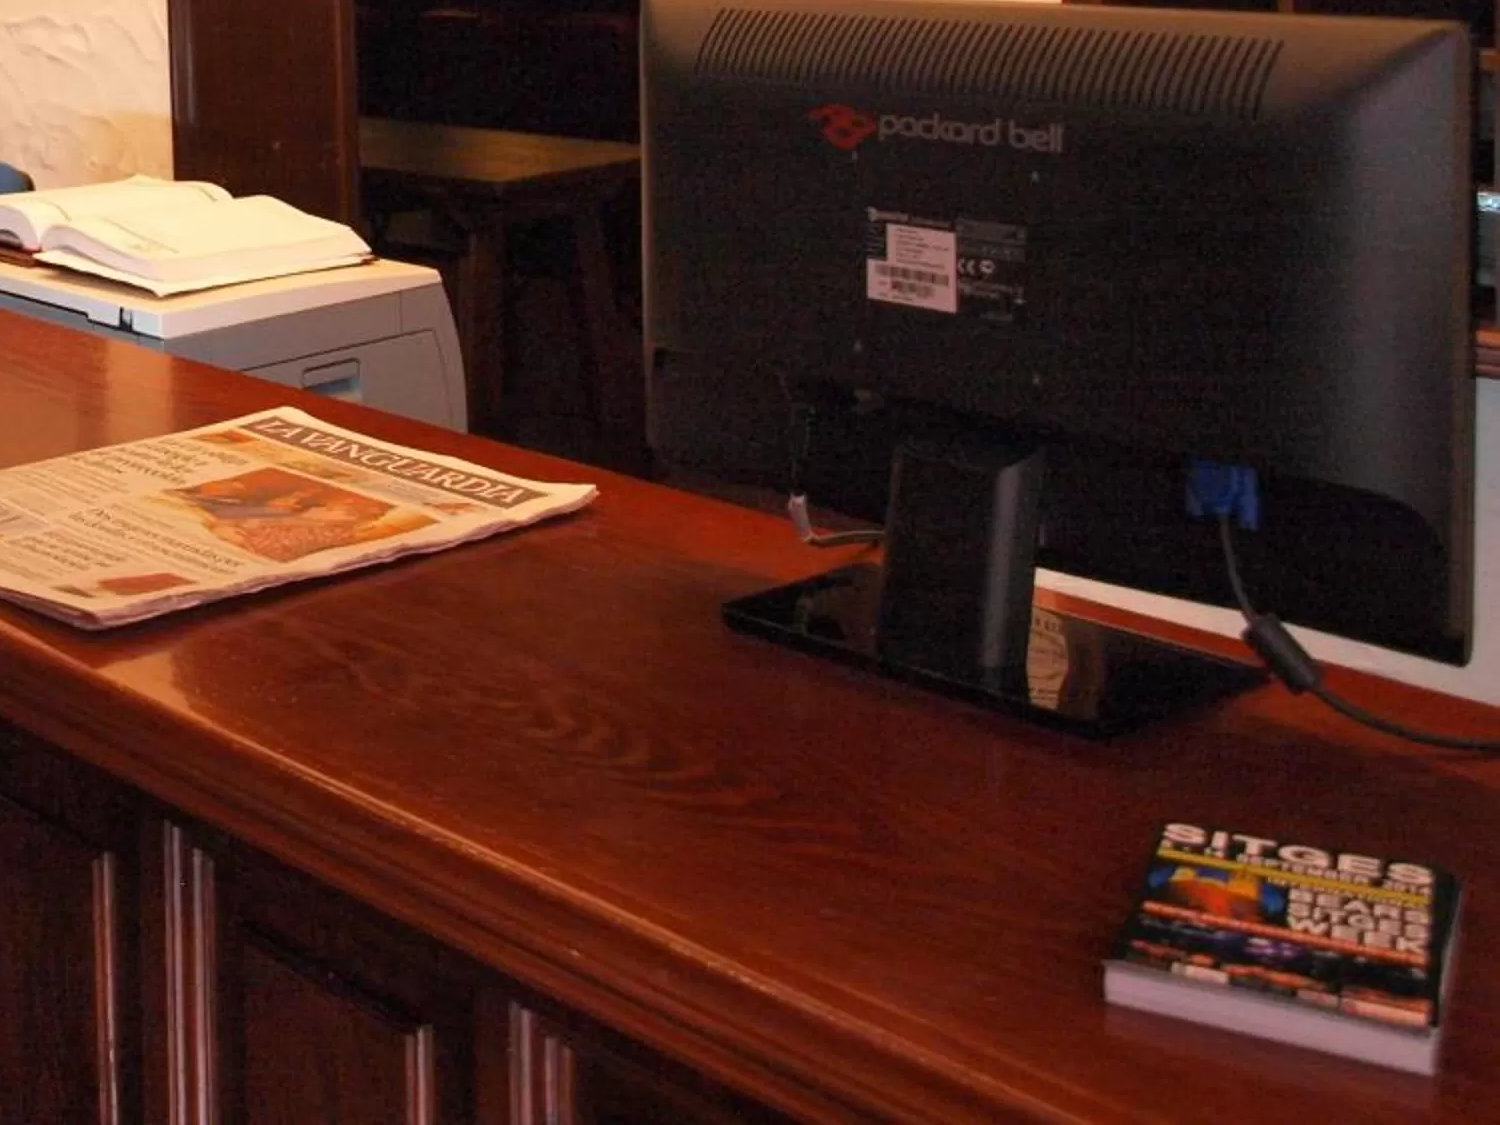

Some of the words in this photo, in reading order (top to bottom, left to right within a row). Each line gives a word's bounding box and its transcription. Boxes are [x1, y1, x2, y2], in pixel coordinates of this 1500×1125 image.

[878, 112, 1001, 146] packard
[1007, 120, 1065, 154] bell
[254, 419, 302, 440] LA
[300, 430, 526, 505] VANGUARDIA
[1161, 822, 1434, 886] SITGES
[1287, 901, 1430, 941] SITGES
[1288, 887, 1430, 925] BEARS
[1288, 914, 1428, 957] WEEK
